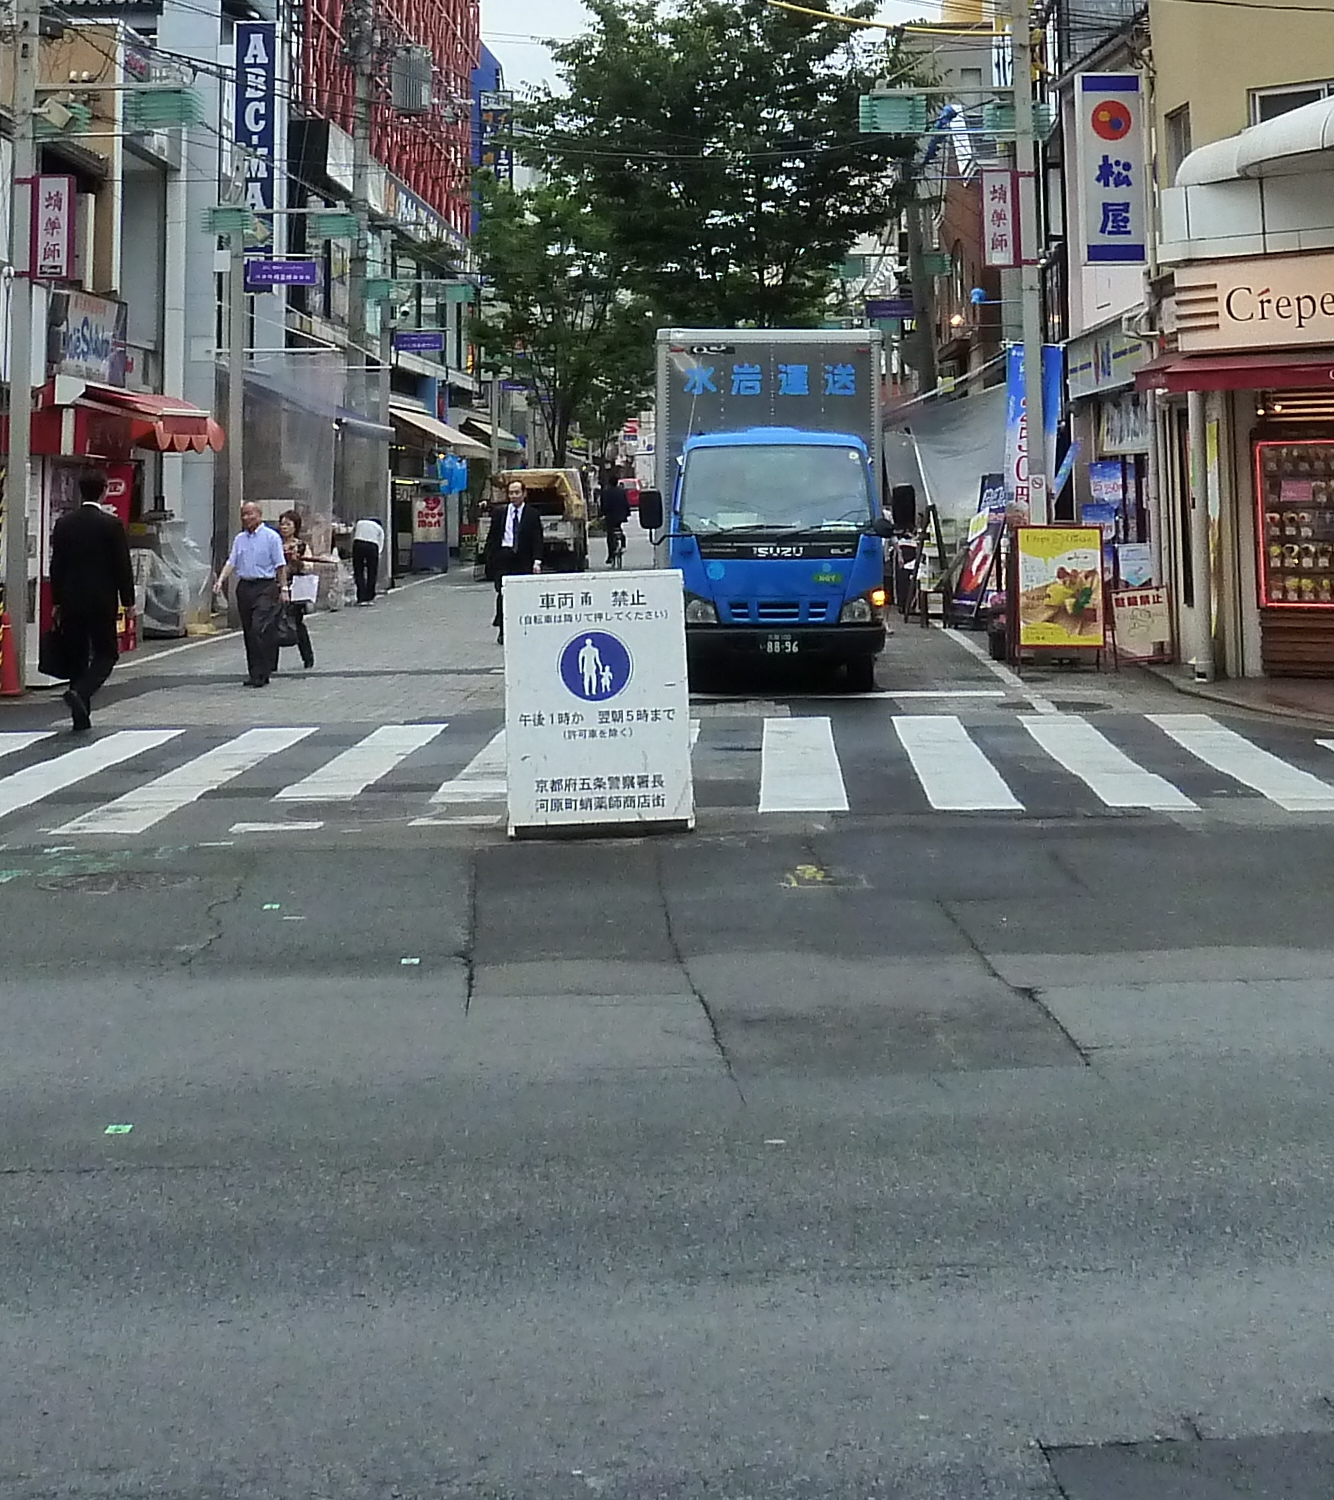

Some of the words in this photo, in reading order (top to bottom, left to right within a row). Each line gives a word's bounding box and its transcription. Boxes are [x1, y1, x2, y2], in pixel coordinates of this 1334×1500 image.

[1095, 154, 1133, 235] 松屋
[683, 362, 857, 396] 水岩運送
[752, 546, 804, 557] ISUZU
[534, 774, 665, 793] 京都府五条警察署長
